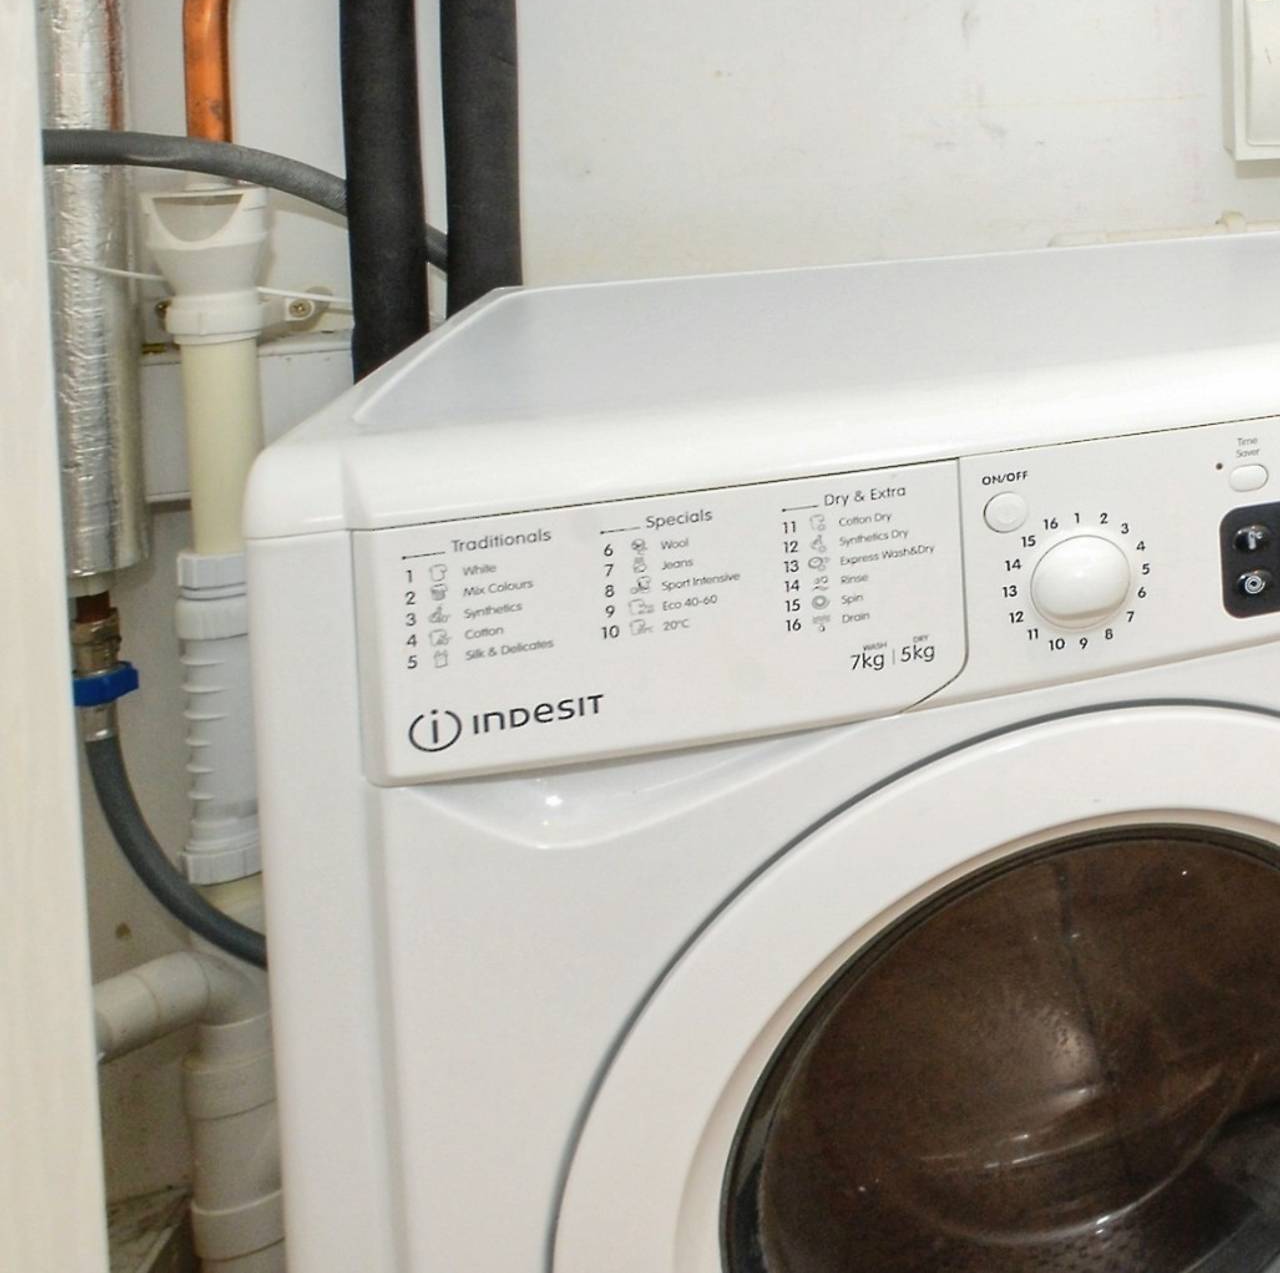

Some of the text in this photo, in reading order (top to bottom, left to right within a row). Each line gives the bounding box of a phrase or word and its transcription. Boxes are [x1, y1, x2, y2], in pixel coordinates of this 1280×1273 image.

[1237, 437, 1258, 447] Time
[1235, 447, 1260, 459] Saver
[982, 470, 1029, 486] ON/OFF
[824, 487, 906, 507] Dry & Extra
[645, 509, 713, 530] Specials
[783, 512, 892, 534] 11 Cotton Dry
[1043, 518, 1059, 530] 16
[1074, 513, 1080, 524] 1
[1100, 512, 1108, 524] 2
[1120, 523, 1129, 534] 3
[451, 529, 552, 553] Traditionals
[603, 538, 690, 557] 6 Wool
[783, 528, 909, 554] 12 Synthetics Dry
[1021, 535, 1036, 547] 15
[1136, 541, 1146, 551] 4
[604, 557, 694, 577] 7 Jeans
[784, 560, 800, 573] 13
[840, 553, 879, 567] Express
[1005, 559, 1021, 571] 14
[1142, 563, 1150, 575] 5
[405, 563, 496, 583] 1 White
[604, 572, 741, 598] 8 Sport Intensive
[785, 574, 869, 592] 14 Rinse
[1002, 585, 1017, 597] 13
[405, 579, 534, 605] 2 Mix Colours
[1137, 586, 1146, 598] 6
[605, 594, 718, 618] 9 Eco 40-60
[785, 593, 864, 612] 15 Spin
[405, 602, 523, 626] 3 Synthetics
[786, 612, 870, 632] 16 Drain
[1009, 611, 1024, 623] 12
[1127, 611, 1135, 623] 7
[406, 627, 504, 647] 4 Cotton
[601, 625, 620, 639] 10
[1027, 629, 1039, 640] 11
[1105, 628, 1113, 640] 8
[1049, 638, 1065, 651] 10
[1079, 638, 1088, 649] 9
[407, 655, 418, 669] 5
[465, 646, 485, 661] Silk
[501, 639, 554, 656] Delicates
[850, 644, 936, 672] 7kg 5kg
